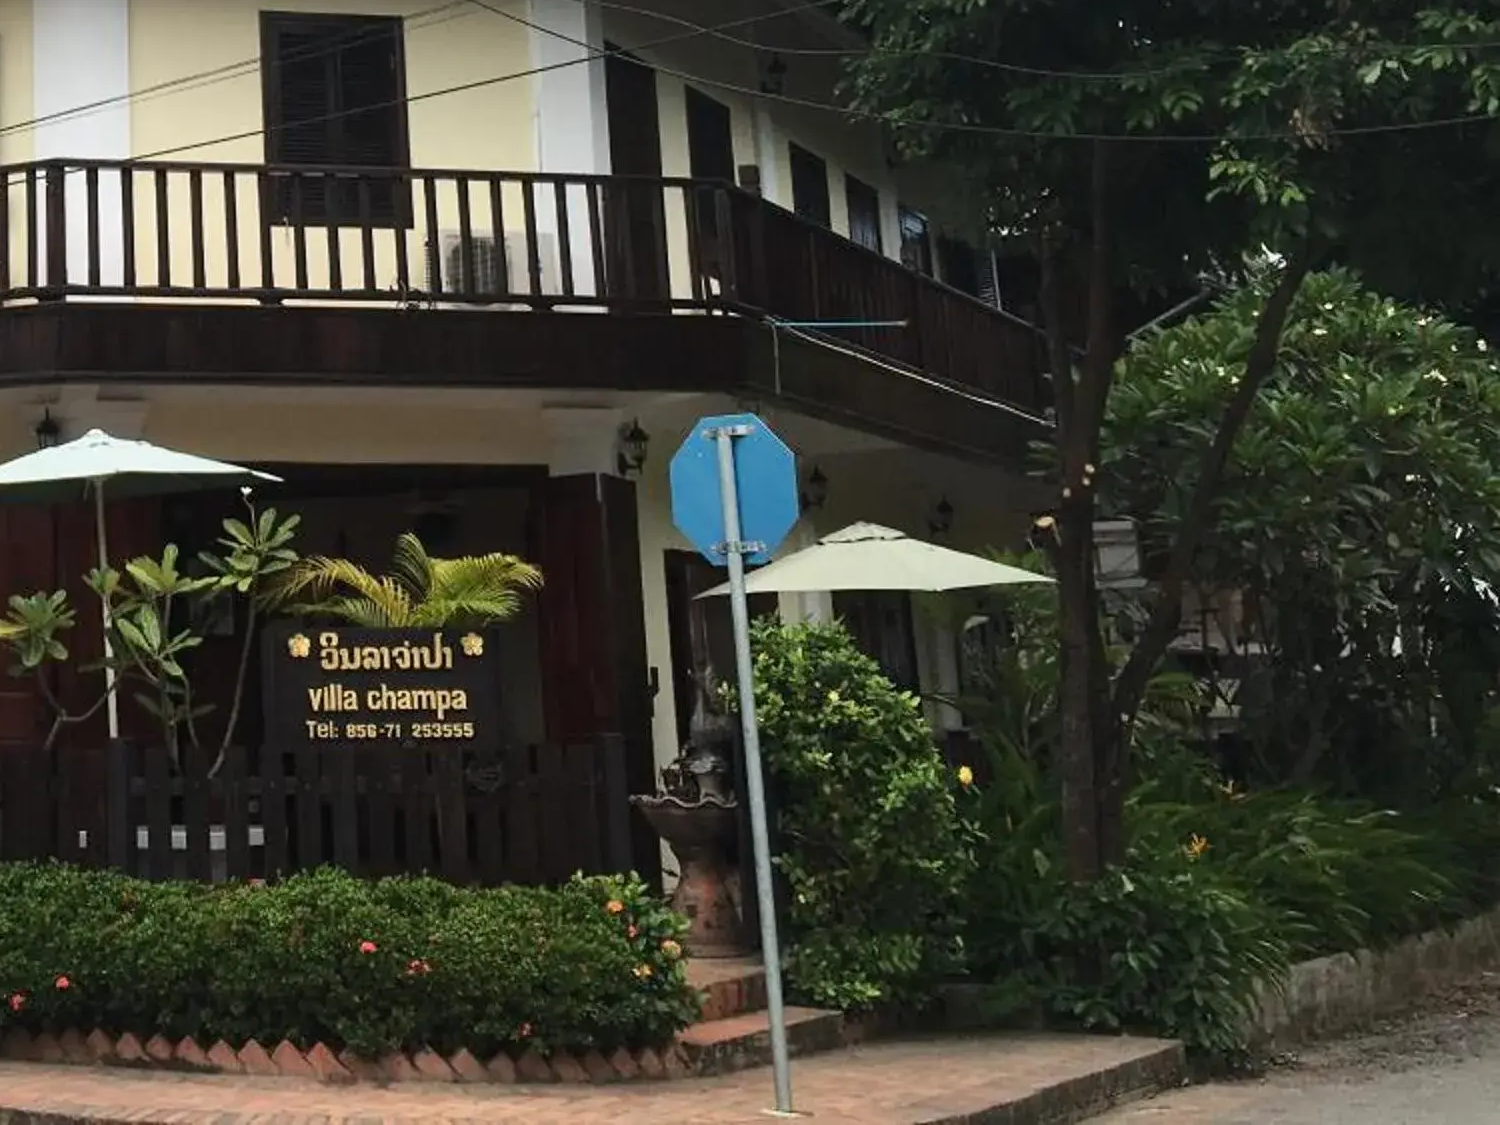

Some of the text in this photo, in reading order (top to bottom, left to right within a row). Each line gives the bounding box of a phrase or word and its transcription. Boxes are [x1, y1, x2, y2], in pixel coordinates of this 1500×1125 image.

[367, 683, 468, 720] champa
[305, 720, 475, 739] Tel: 856-71 253555
